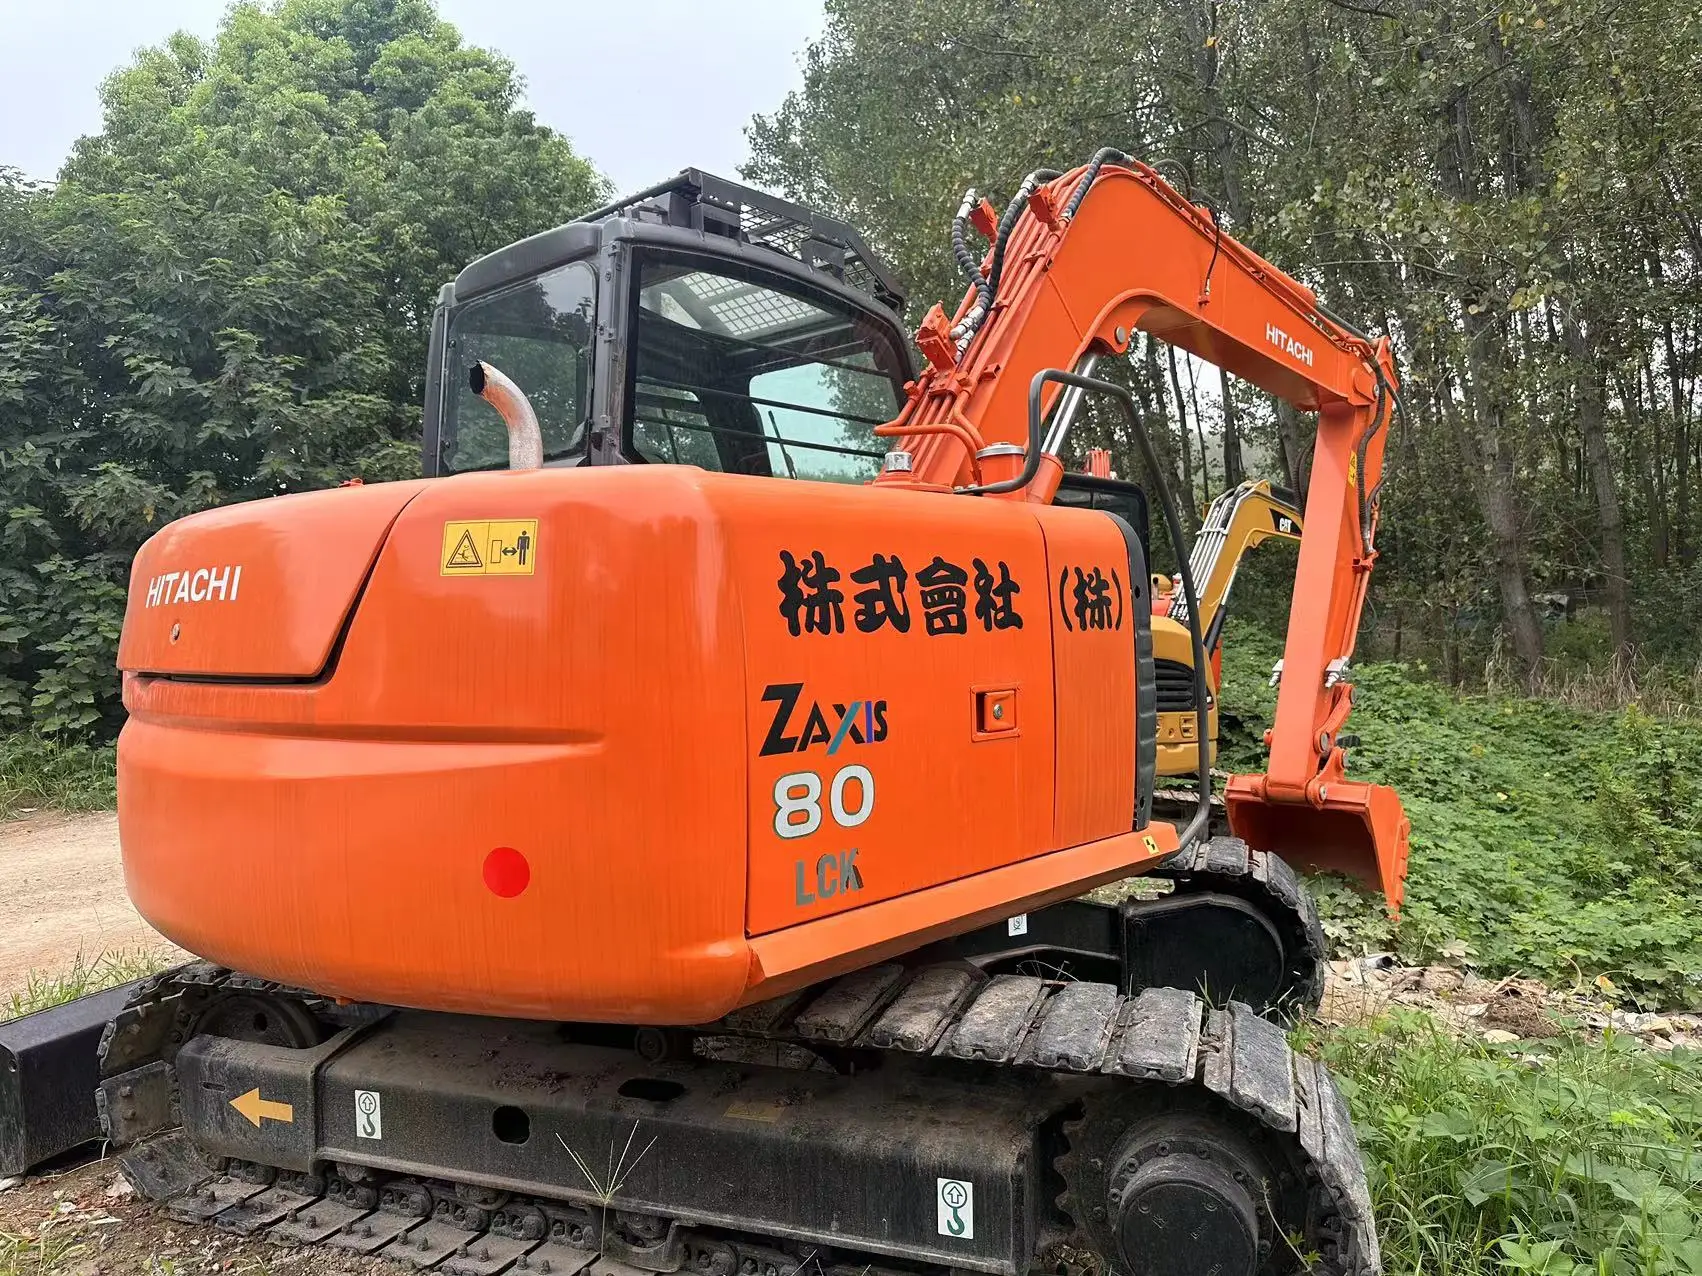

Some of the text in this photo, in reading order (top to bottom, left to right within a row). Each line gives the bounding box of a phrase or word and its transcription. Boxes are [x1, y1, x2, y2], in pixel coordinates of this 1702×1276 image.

[1265, 322, 1313, 367] HITACHI
[1279, 517, 1292, 533] CAT
[145, 565, 242, 609] HITACHI
[778, 550, 1023, 637] 株式會社
[773, 764, 875, 840] 80
[795, 848, 864, 906] LCK
